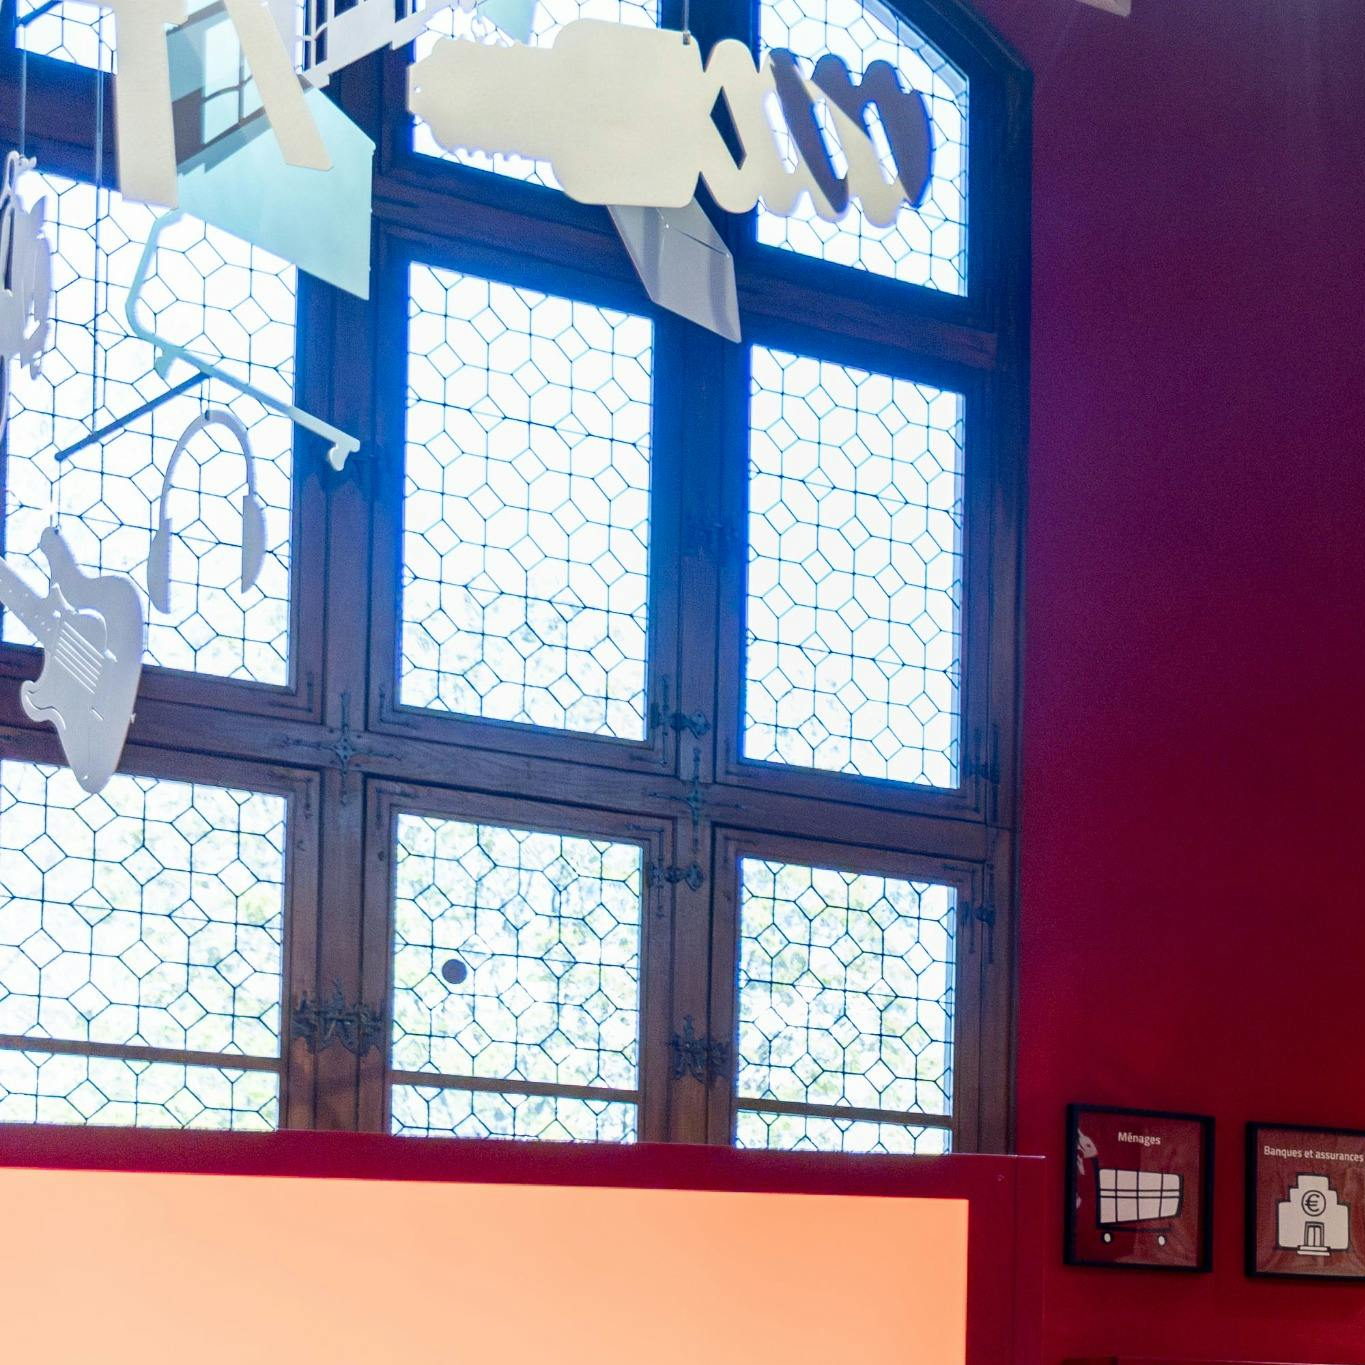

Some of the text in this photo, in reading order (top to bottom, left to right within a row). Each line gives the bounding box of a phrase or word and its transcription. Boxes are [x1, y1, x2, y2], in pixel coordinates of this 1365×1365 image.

[1118, 1131, 1161, 1147] Ménages
[1264, 1145, 1364, 1162] Banques et assurances
